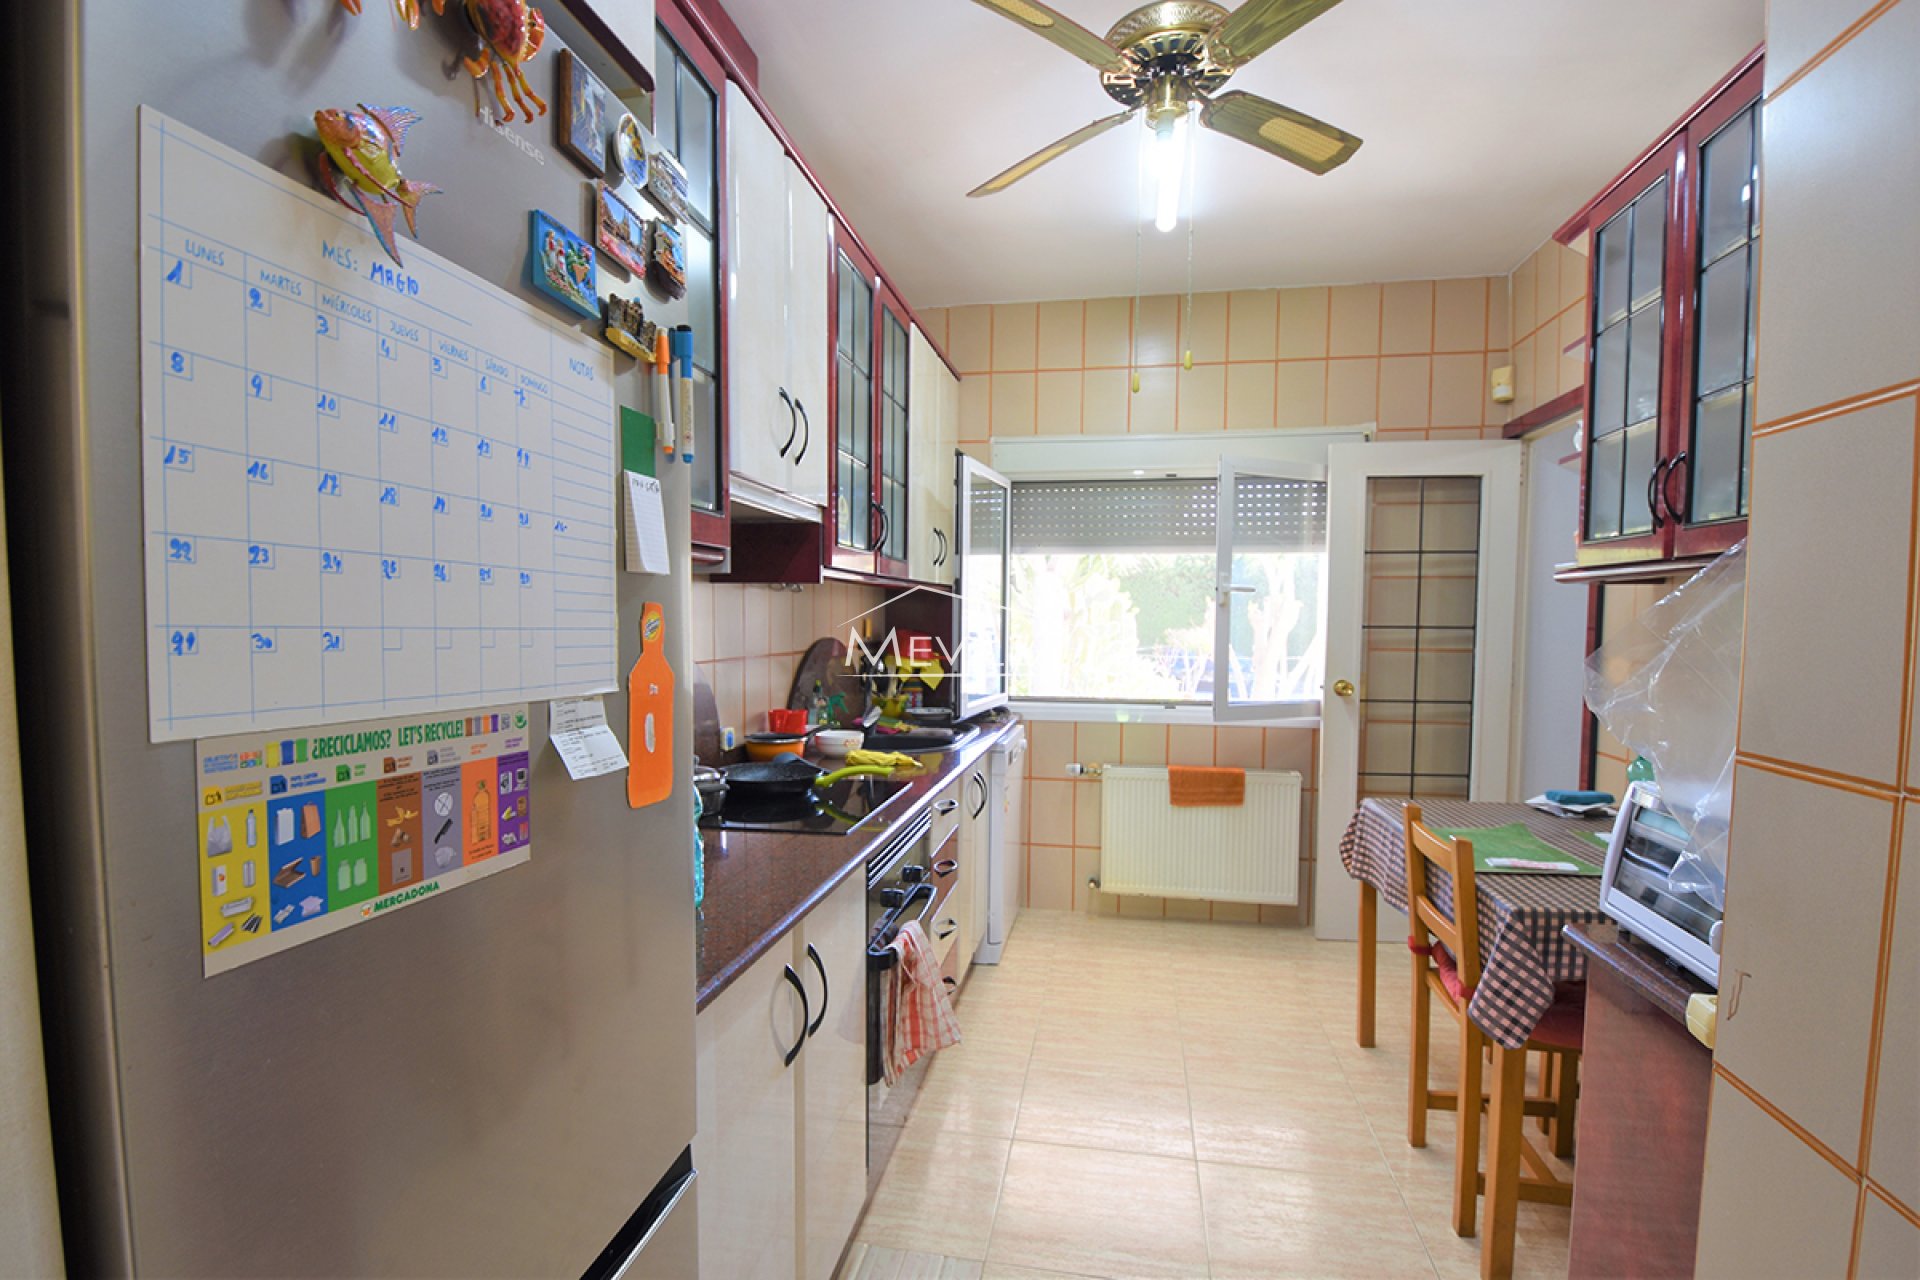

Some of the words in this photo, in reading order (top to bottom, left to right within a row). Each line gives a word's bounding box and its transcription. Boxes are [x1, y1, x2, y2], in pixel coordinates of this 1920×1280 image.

[322, 240, 359, 272] MES:
[184, 239, 225, 266] LUNES
[260, 269, 302, 296] MARTES
[390, 320, 419, 342] JUEVES
[568, 357, 595, 381] NOTAS
[166, 258, 184, 285] 1
[249, 287, 264, 309] 2
[315, 314, 330, 336] 3
[380, 338, 391, 358] 4
[479, 375, 487, 392] 6
[513, 388, 527, 406] 7
[170, 351, 185, 373] 8
[251, 373, 264, 398] 9
[316, 394, 336, 411] 10
[378, 413, 397, 431] 11
[431, 428, 448, 443] 12
[163, 445, 193, 465] 15
[246, 460, 269, 481] 16
[317, 473, 339, 496] 17
[169, 537, 192, 562] 22
[247, 544, 270, 566] 23
[321, 551, 343, 573] 24
[251, 632, 273, 650] 30
[311, 728, 393, 760] ¿RECICLAMOS?
[398, 723, 423, 747] LET'S
[424, 719, 464, 743] RECYCLE!
[373, 881, 440, 913] MERCADONA
